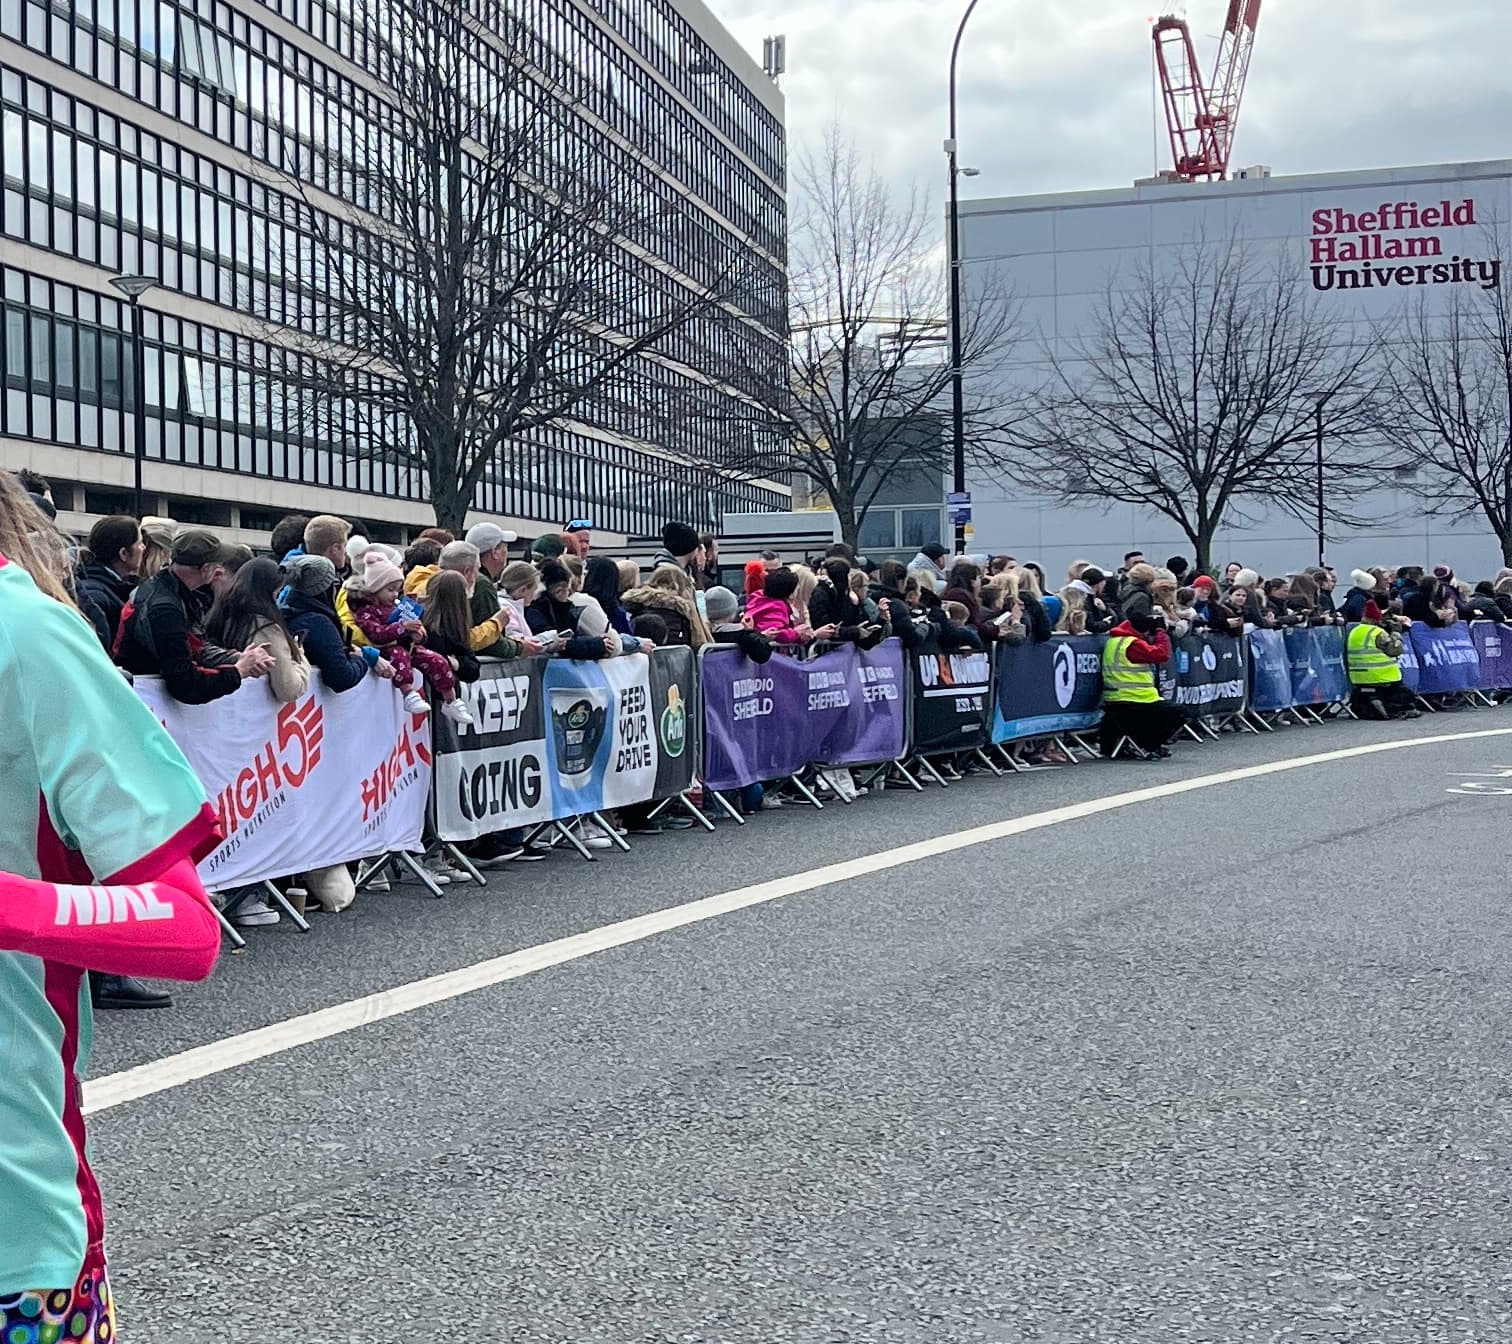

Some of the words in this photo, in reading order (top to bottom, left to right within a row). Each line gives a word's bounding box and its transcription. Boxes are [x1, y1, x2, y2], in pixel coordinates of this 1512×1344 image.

[1312, 199, 1476, 236] Sheffield
[1310, 234, 1442, 263] Hallam
[1310, 256, 1501, 291] University
[457, 674, 531, 736] KEEP
[619, 684, 646, 713] FEED
[619, 716, 650, 747] YOUR
[615, 744, 652, 773] DRIVE
[209, 837, 242, 874] SPORTS
[243, 791, 287, 841] NUTRITION
